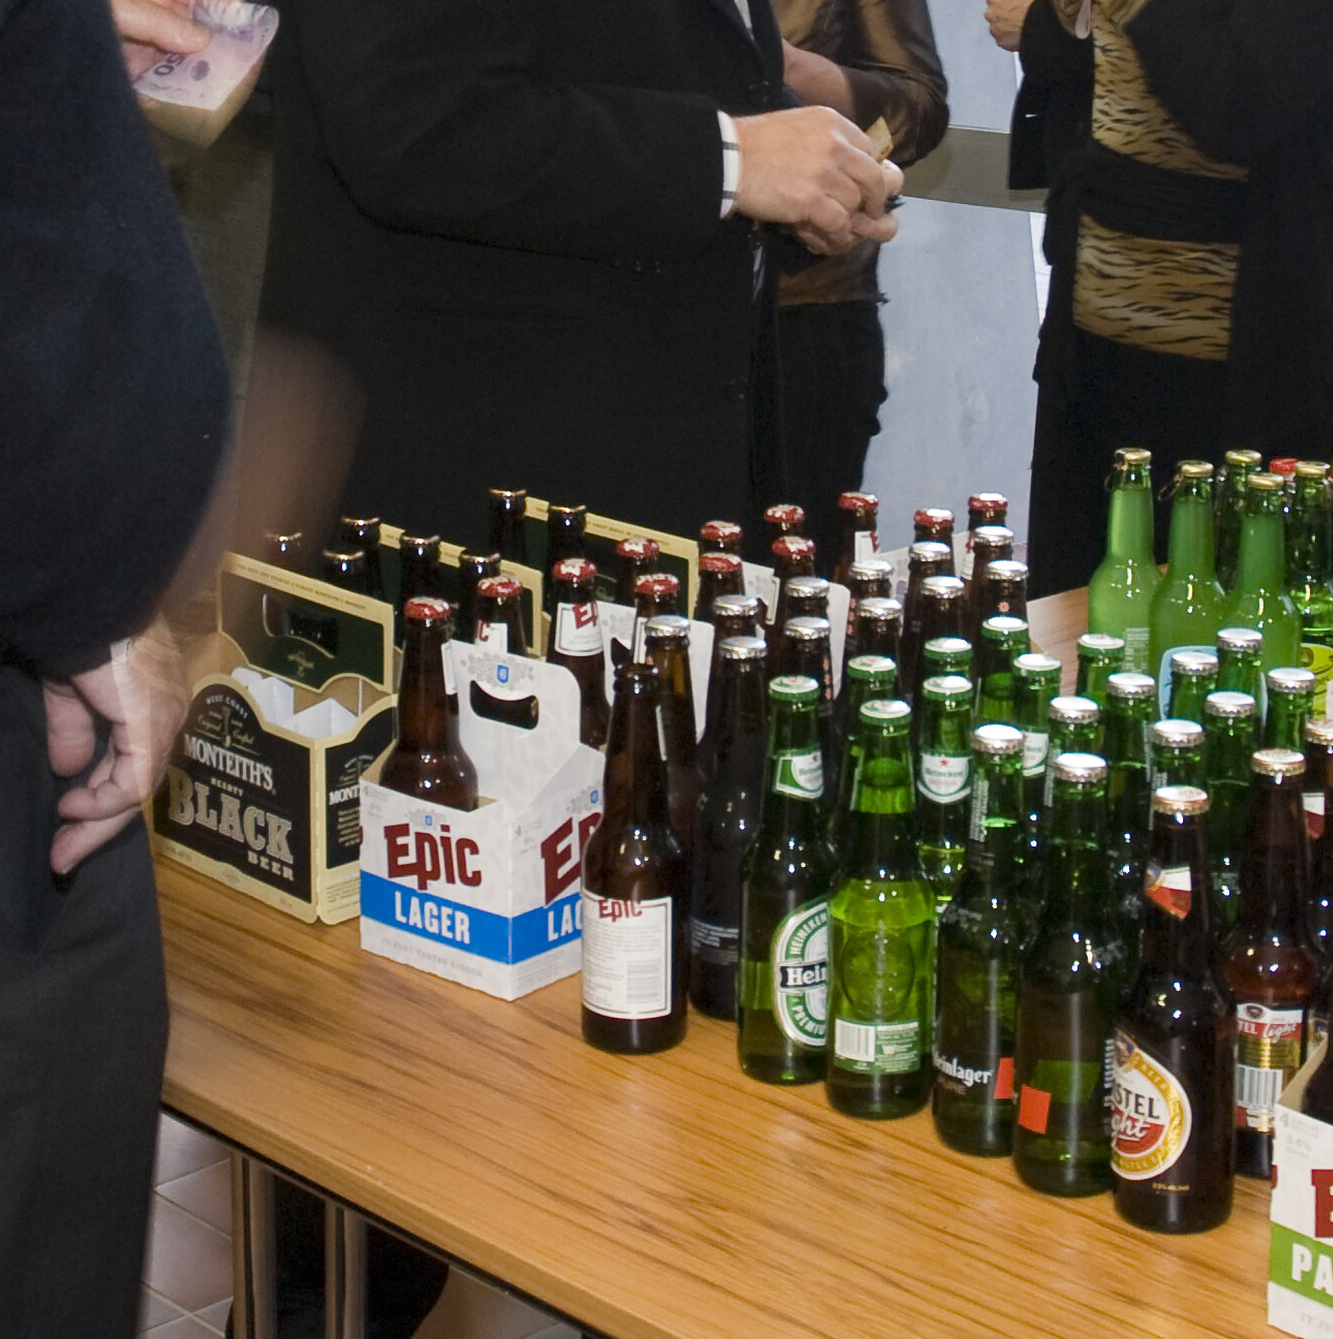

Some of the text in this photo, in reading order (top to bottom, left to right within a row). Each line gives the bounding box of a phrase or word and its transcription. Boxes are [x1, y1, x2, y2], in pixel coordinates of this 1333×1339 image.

[184, 734, 274, 793] MONTEITH'S
[168, 765, 294, 865] BLACK
[247, 849, 294, 881] BEER
[384, 823, 482, 891] Epic
[394, 890, 471, 945] LAGER
